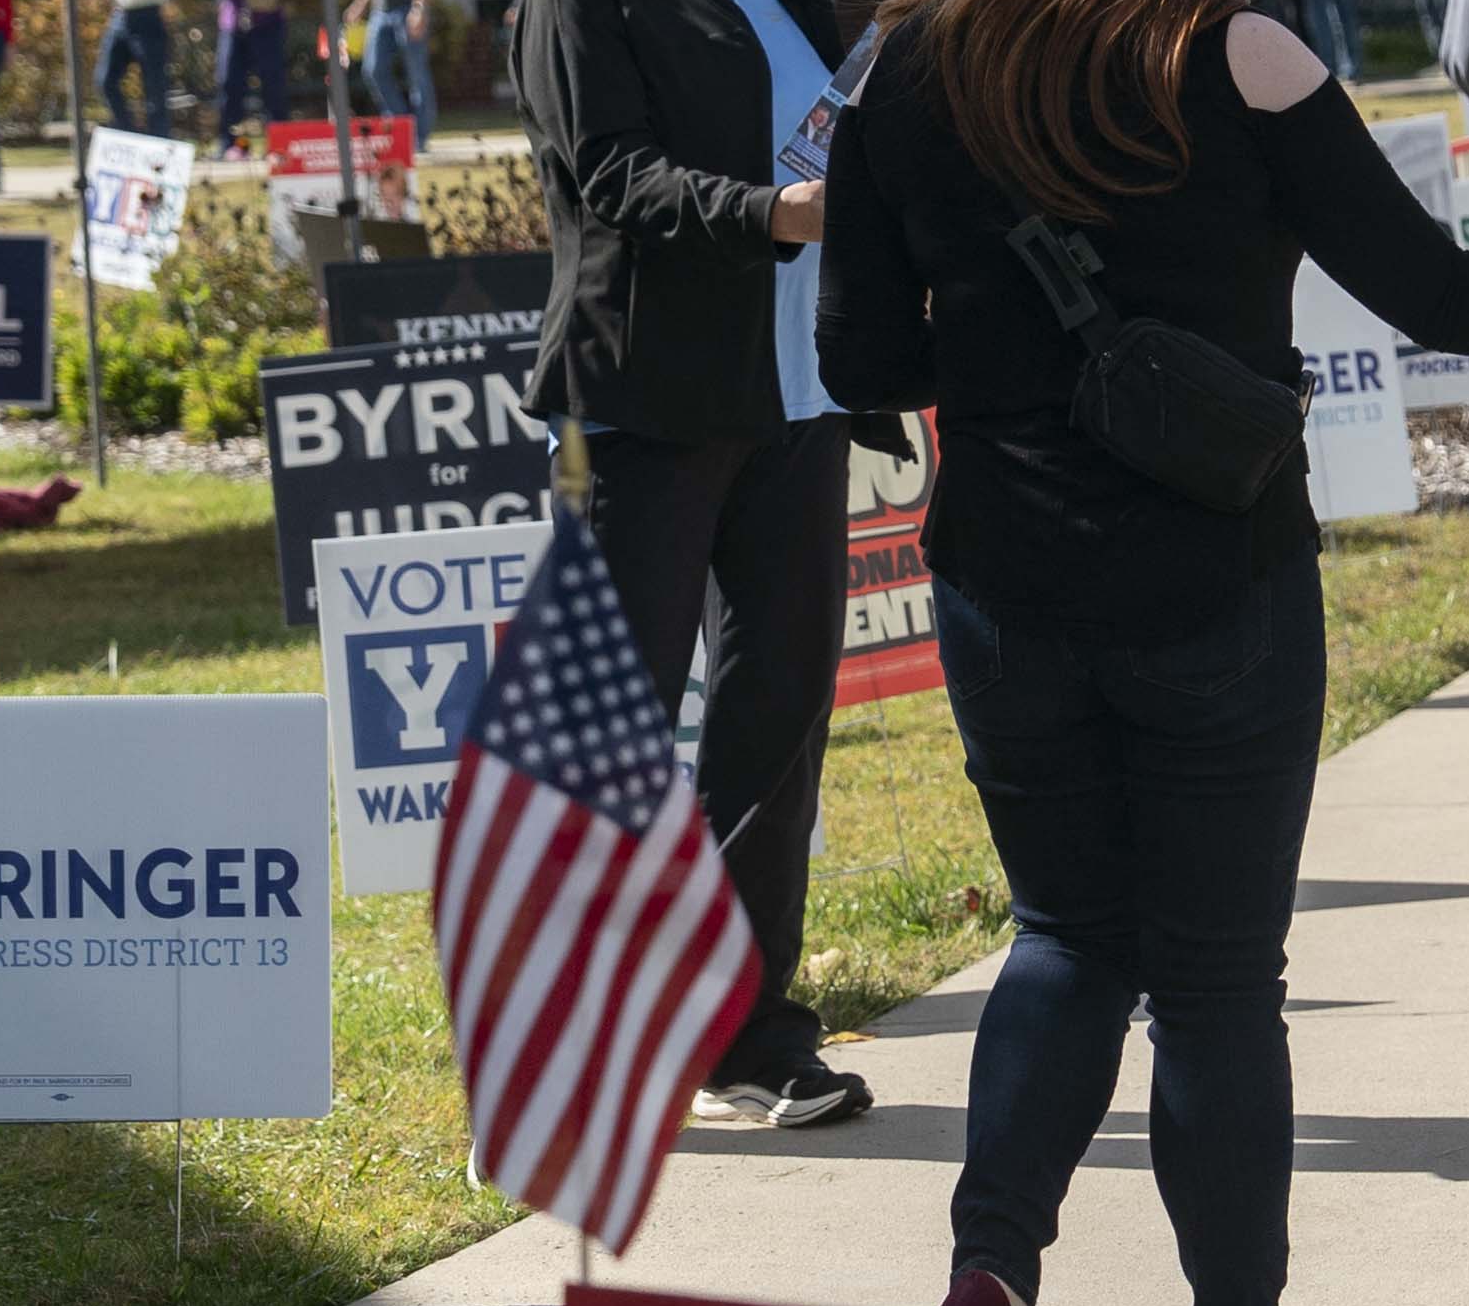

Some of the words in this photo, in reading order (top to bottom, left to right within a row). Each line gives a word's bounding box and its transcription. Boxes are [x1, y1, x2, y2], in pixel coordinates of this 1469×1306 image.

[430, 463, 470, 487] for
[339, 553, 526, 620] VOTE
[83, 937, 247, 968] DISTRICT
[257, 937, 290, 967] 13
